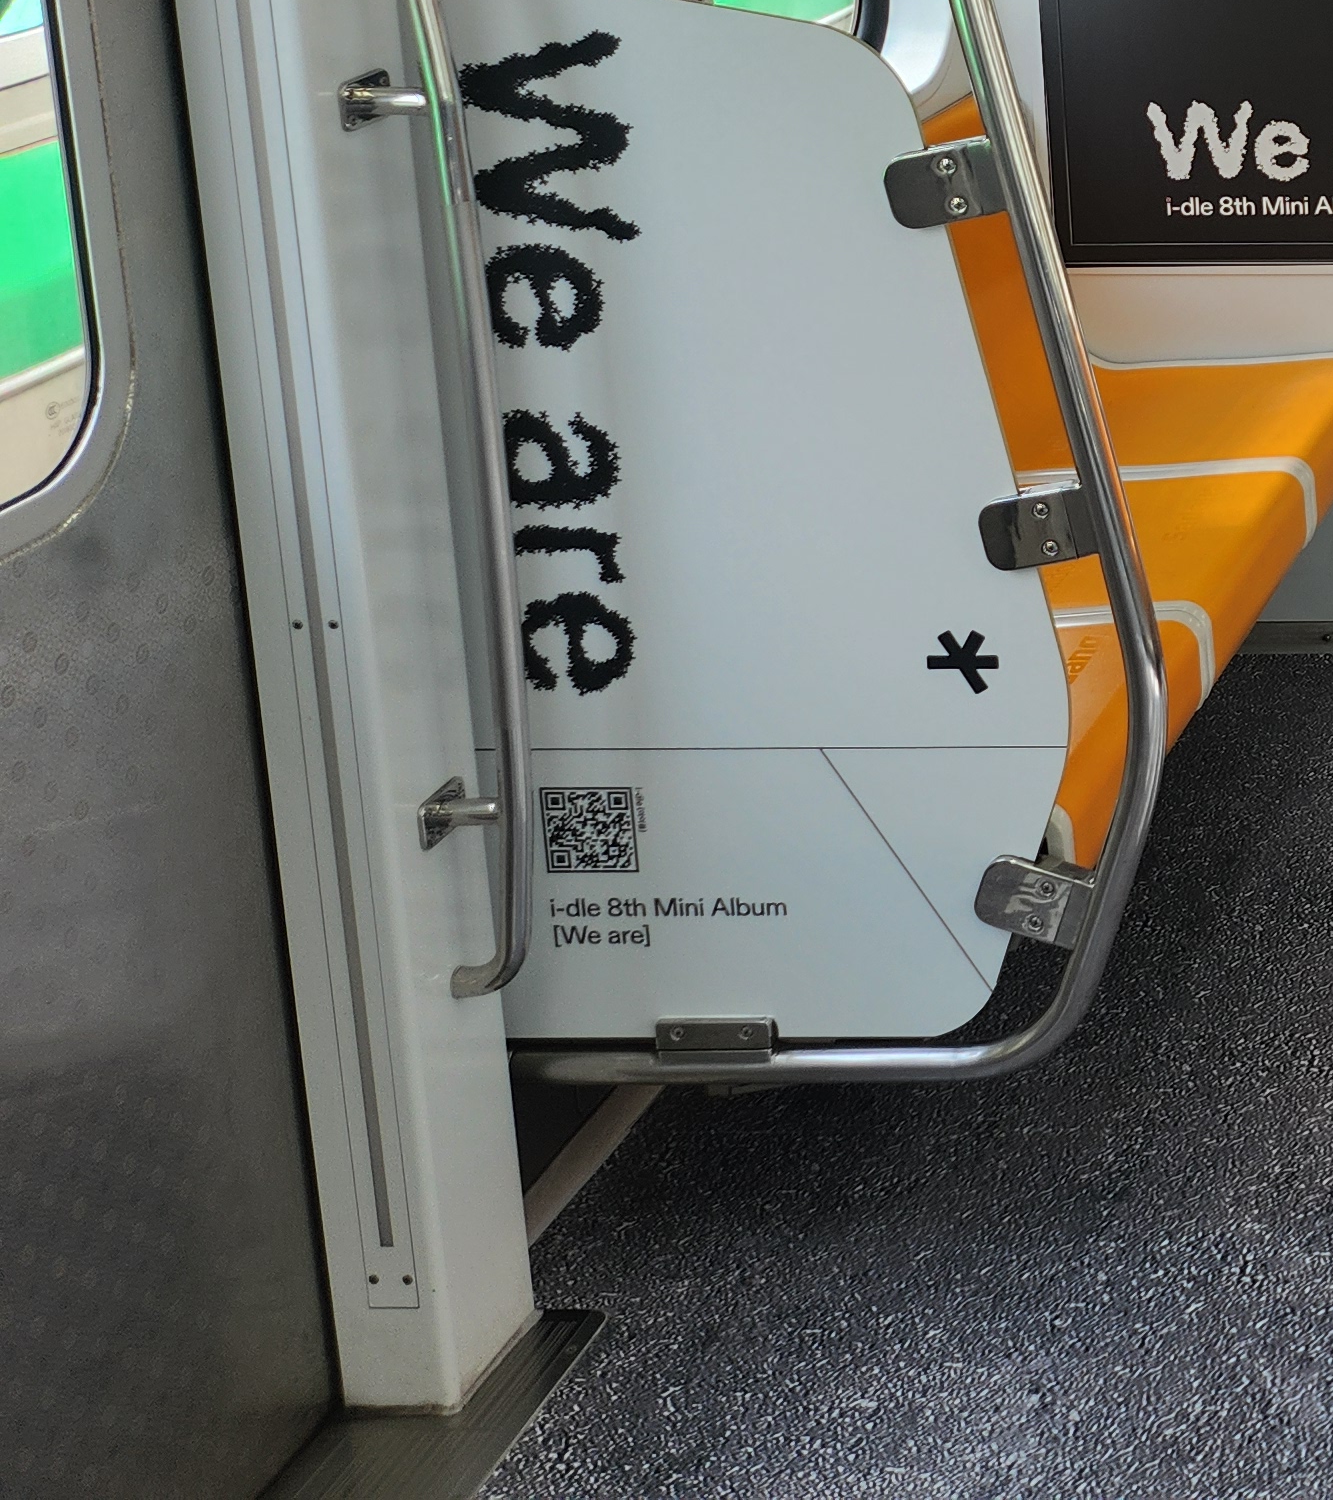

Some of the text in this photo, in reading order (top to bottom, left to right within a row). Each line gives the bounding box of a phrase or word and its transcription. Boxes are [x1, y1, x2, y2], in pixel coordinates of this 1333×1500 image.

[1147, 99, 1311, 182] We
[1166, 196, 1214, 217] i-dle
[1219, 196, 1256, 216] 8th
[1262, 196, 1309, 216] Mini
[461, 31, 641, 696] We are
[550, 897, 788, 918] i-dle 8th Mini Album
[553, 924, 651, 947] [We are]
